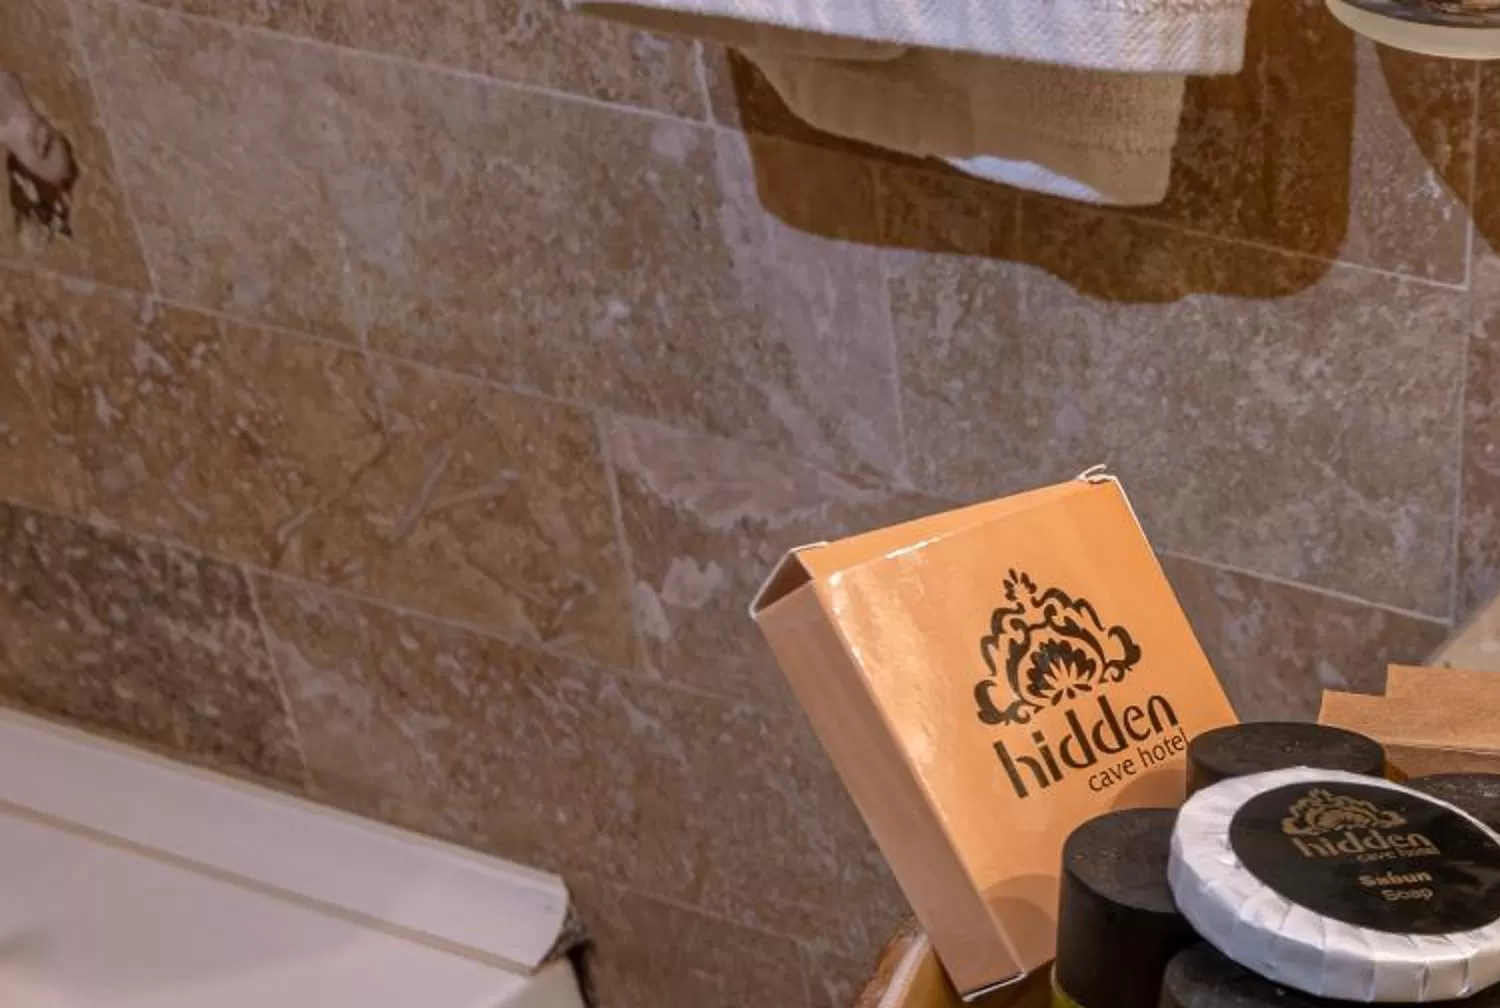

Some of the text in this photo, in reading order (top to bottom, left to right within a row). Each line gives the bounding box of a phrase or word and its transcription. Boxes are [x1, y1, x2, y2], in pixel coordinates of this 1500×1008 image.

[992, 695, 1179, 799] hidden
[1089, 728, 1189, 793] cave hotel
[1292, 829, 1437, 858] hidden
[1358, 870, 1433, 887] Sabun
[1381, 888, 1434, 901] Soap
